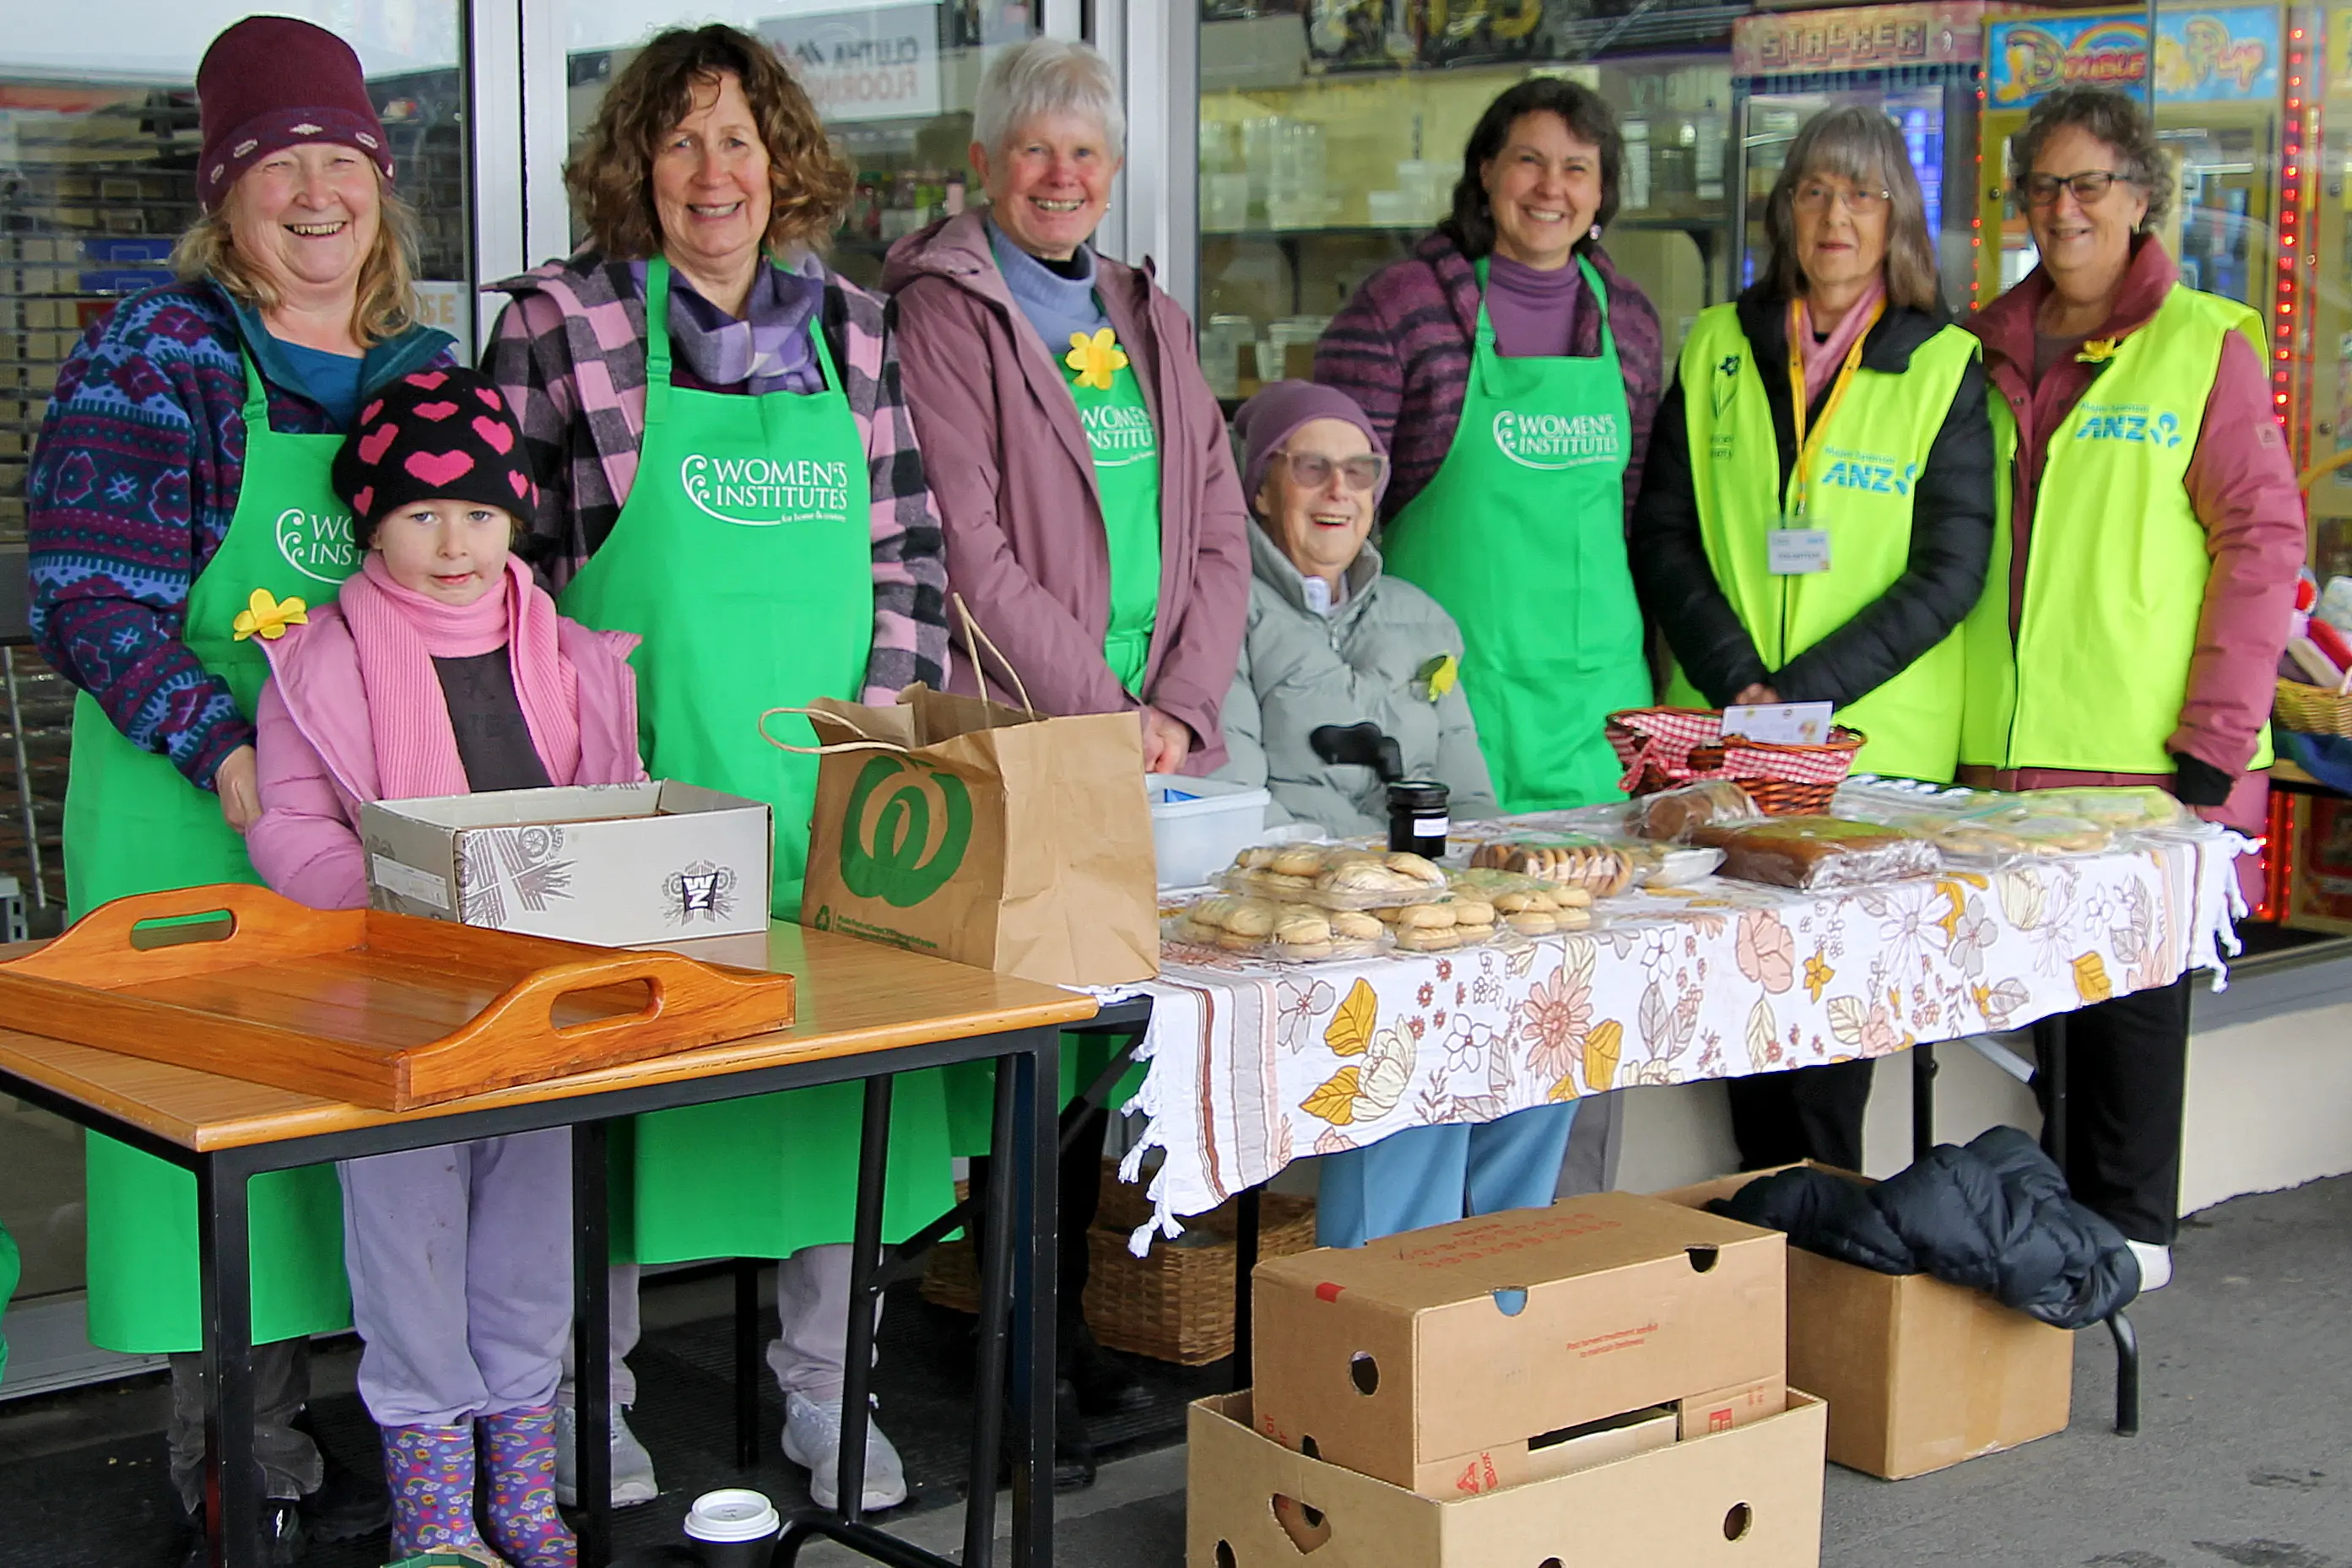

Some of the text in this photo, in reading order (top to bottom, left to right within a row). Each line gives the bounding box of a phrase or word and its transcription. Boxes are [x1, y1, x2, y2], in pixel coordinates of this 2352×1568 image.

[2075, 415, 2147, 441] ANZ
[712, 458, 848, 488] WOMEN'S
[1821, 462, 1894, 493] ANZ
[716, 485, 847, 511] INSTITUTES
